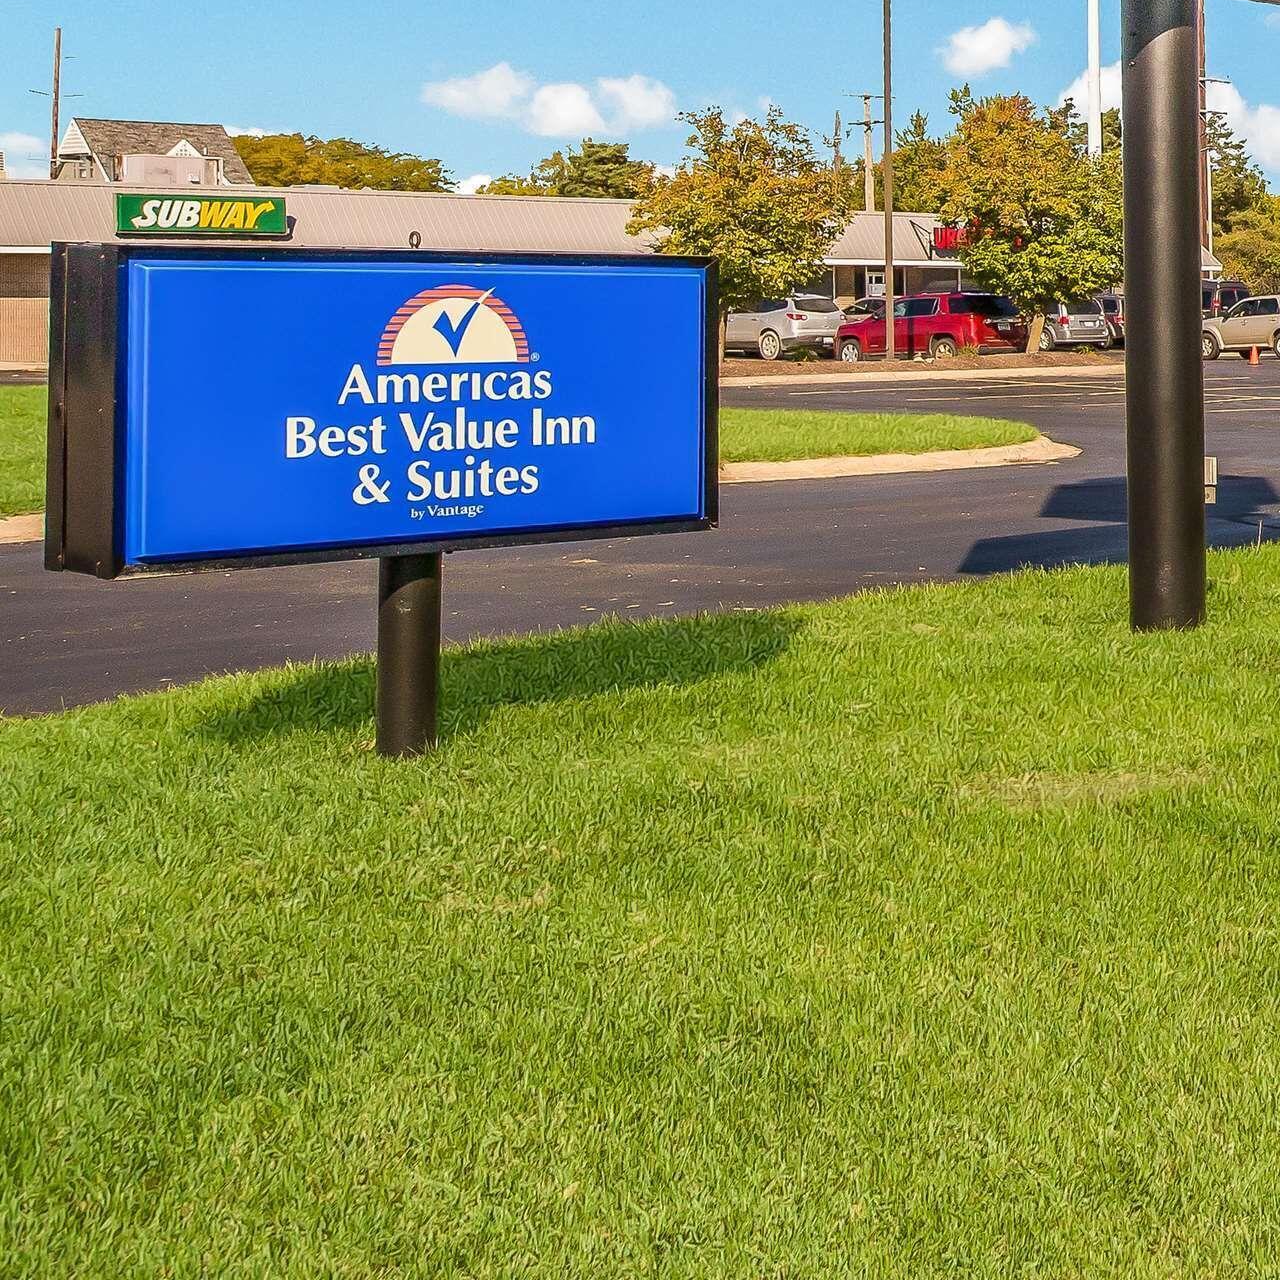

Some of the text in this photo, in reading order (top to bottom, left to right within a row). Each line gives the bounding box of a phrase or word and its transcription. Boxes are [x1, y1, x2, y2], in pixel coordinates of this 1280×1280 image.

[131, 199, 275, 229] SUBWAY
[337, 363, 552, 405] Americas
[286, 406, 596, 458] Best Value Inn
[352, 455, 539, 505] & Suites
[410, 504, 485, 520] by Vantage
